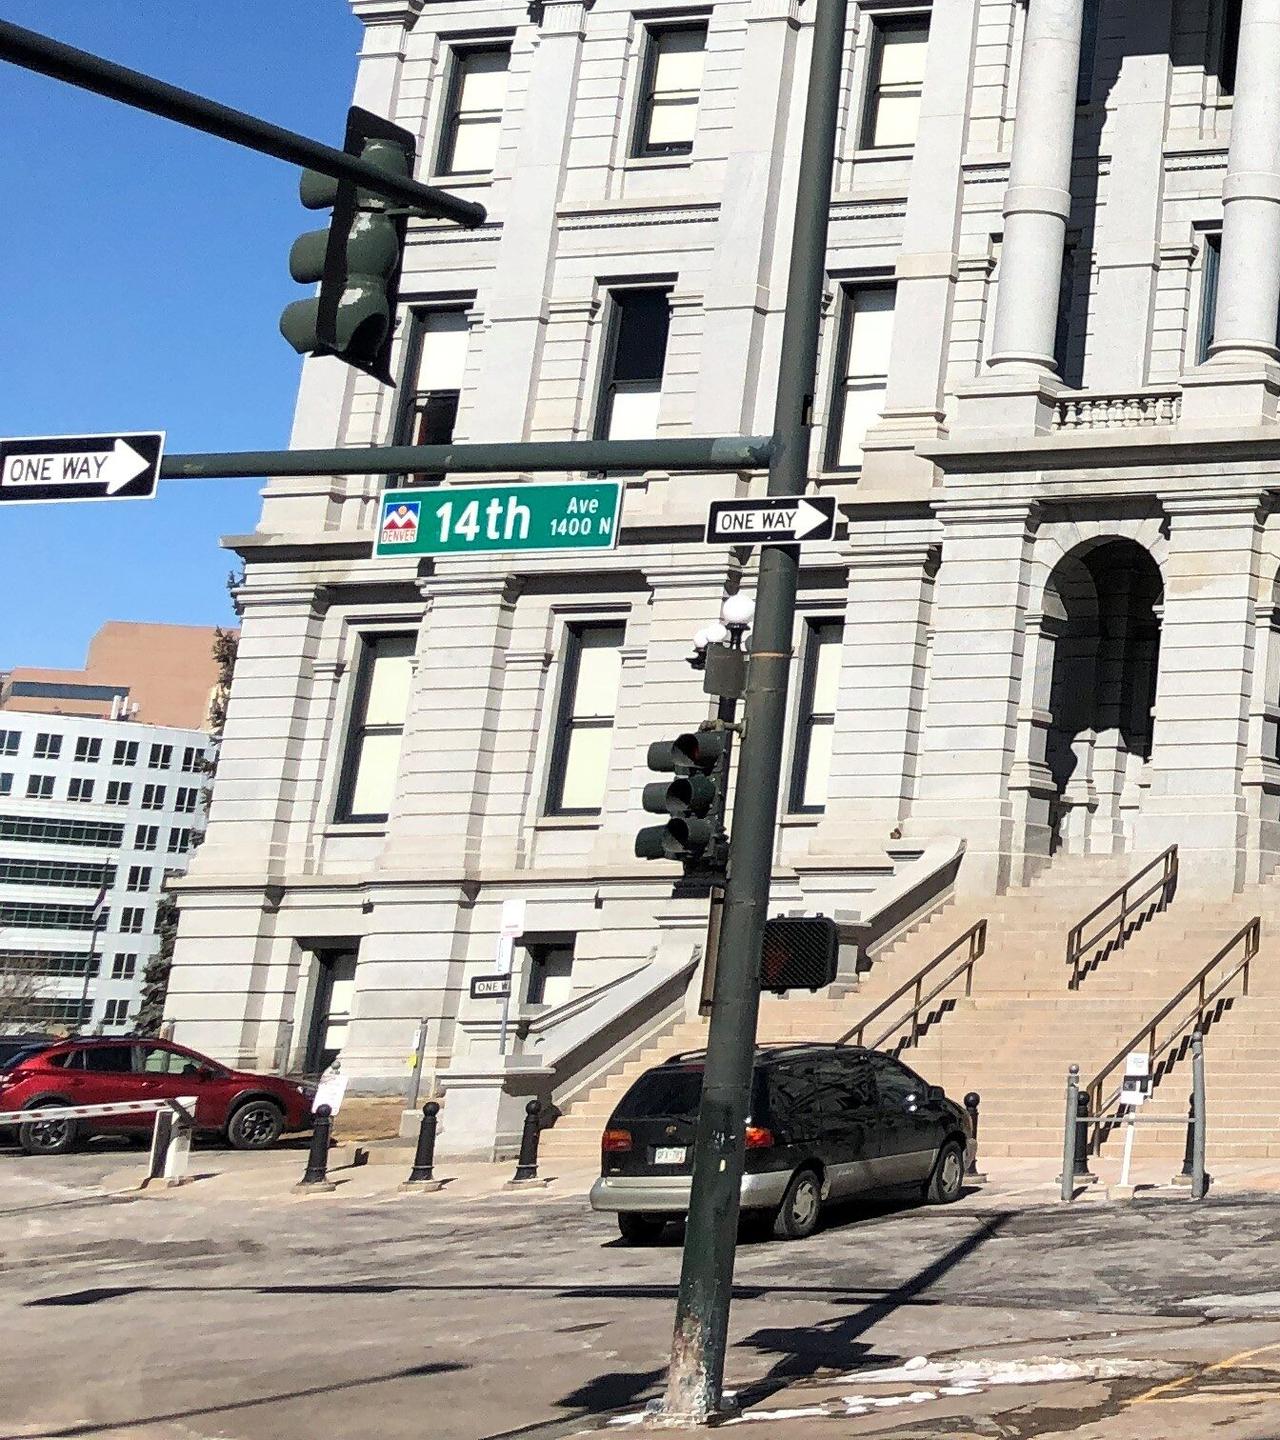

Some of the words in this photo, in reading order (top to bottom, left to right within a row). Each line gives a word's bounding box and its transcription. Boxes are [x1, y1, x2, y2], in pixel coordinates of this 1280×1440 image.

[10, 457, 54, 482] ONE
[62, 455, 108, 480] WAY
[566, 496, 599, 514] Ave
[436, 495, 531, 543] 14th
[550, 517, 592, 536] 1400
[599, 516, 611, 535] N
[721, 513, 755, 530] ONE
[762, 511, 797, 529] WAY
[382, 530, 416, 543] DENVER
[477, 983, 499, 992] ONE
